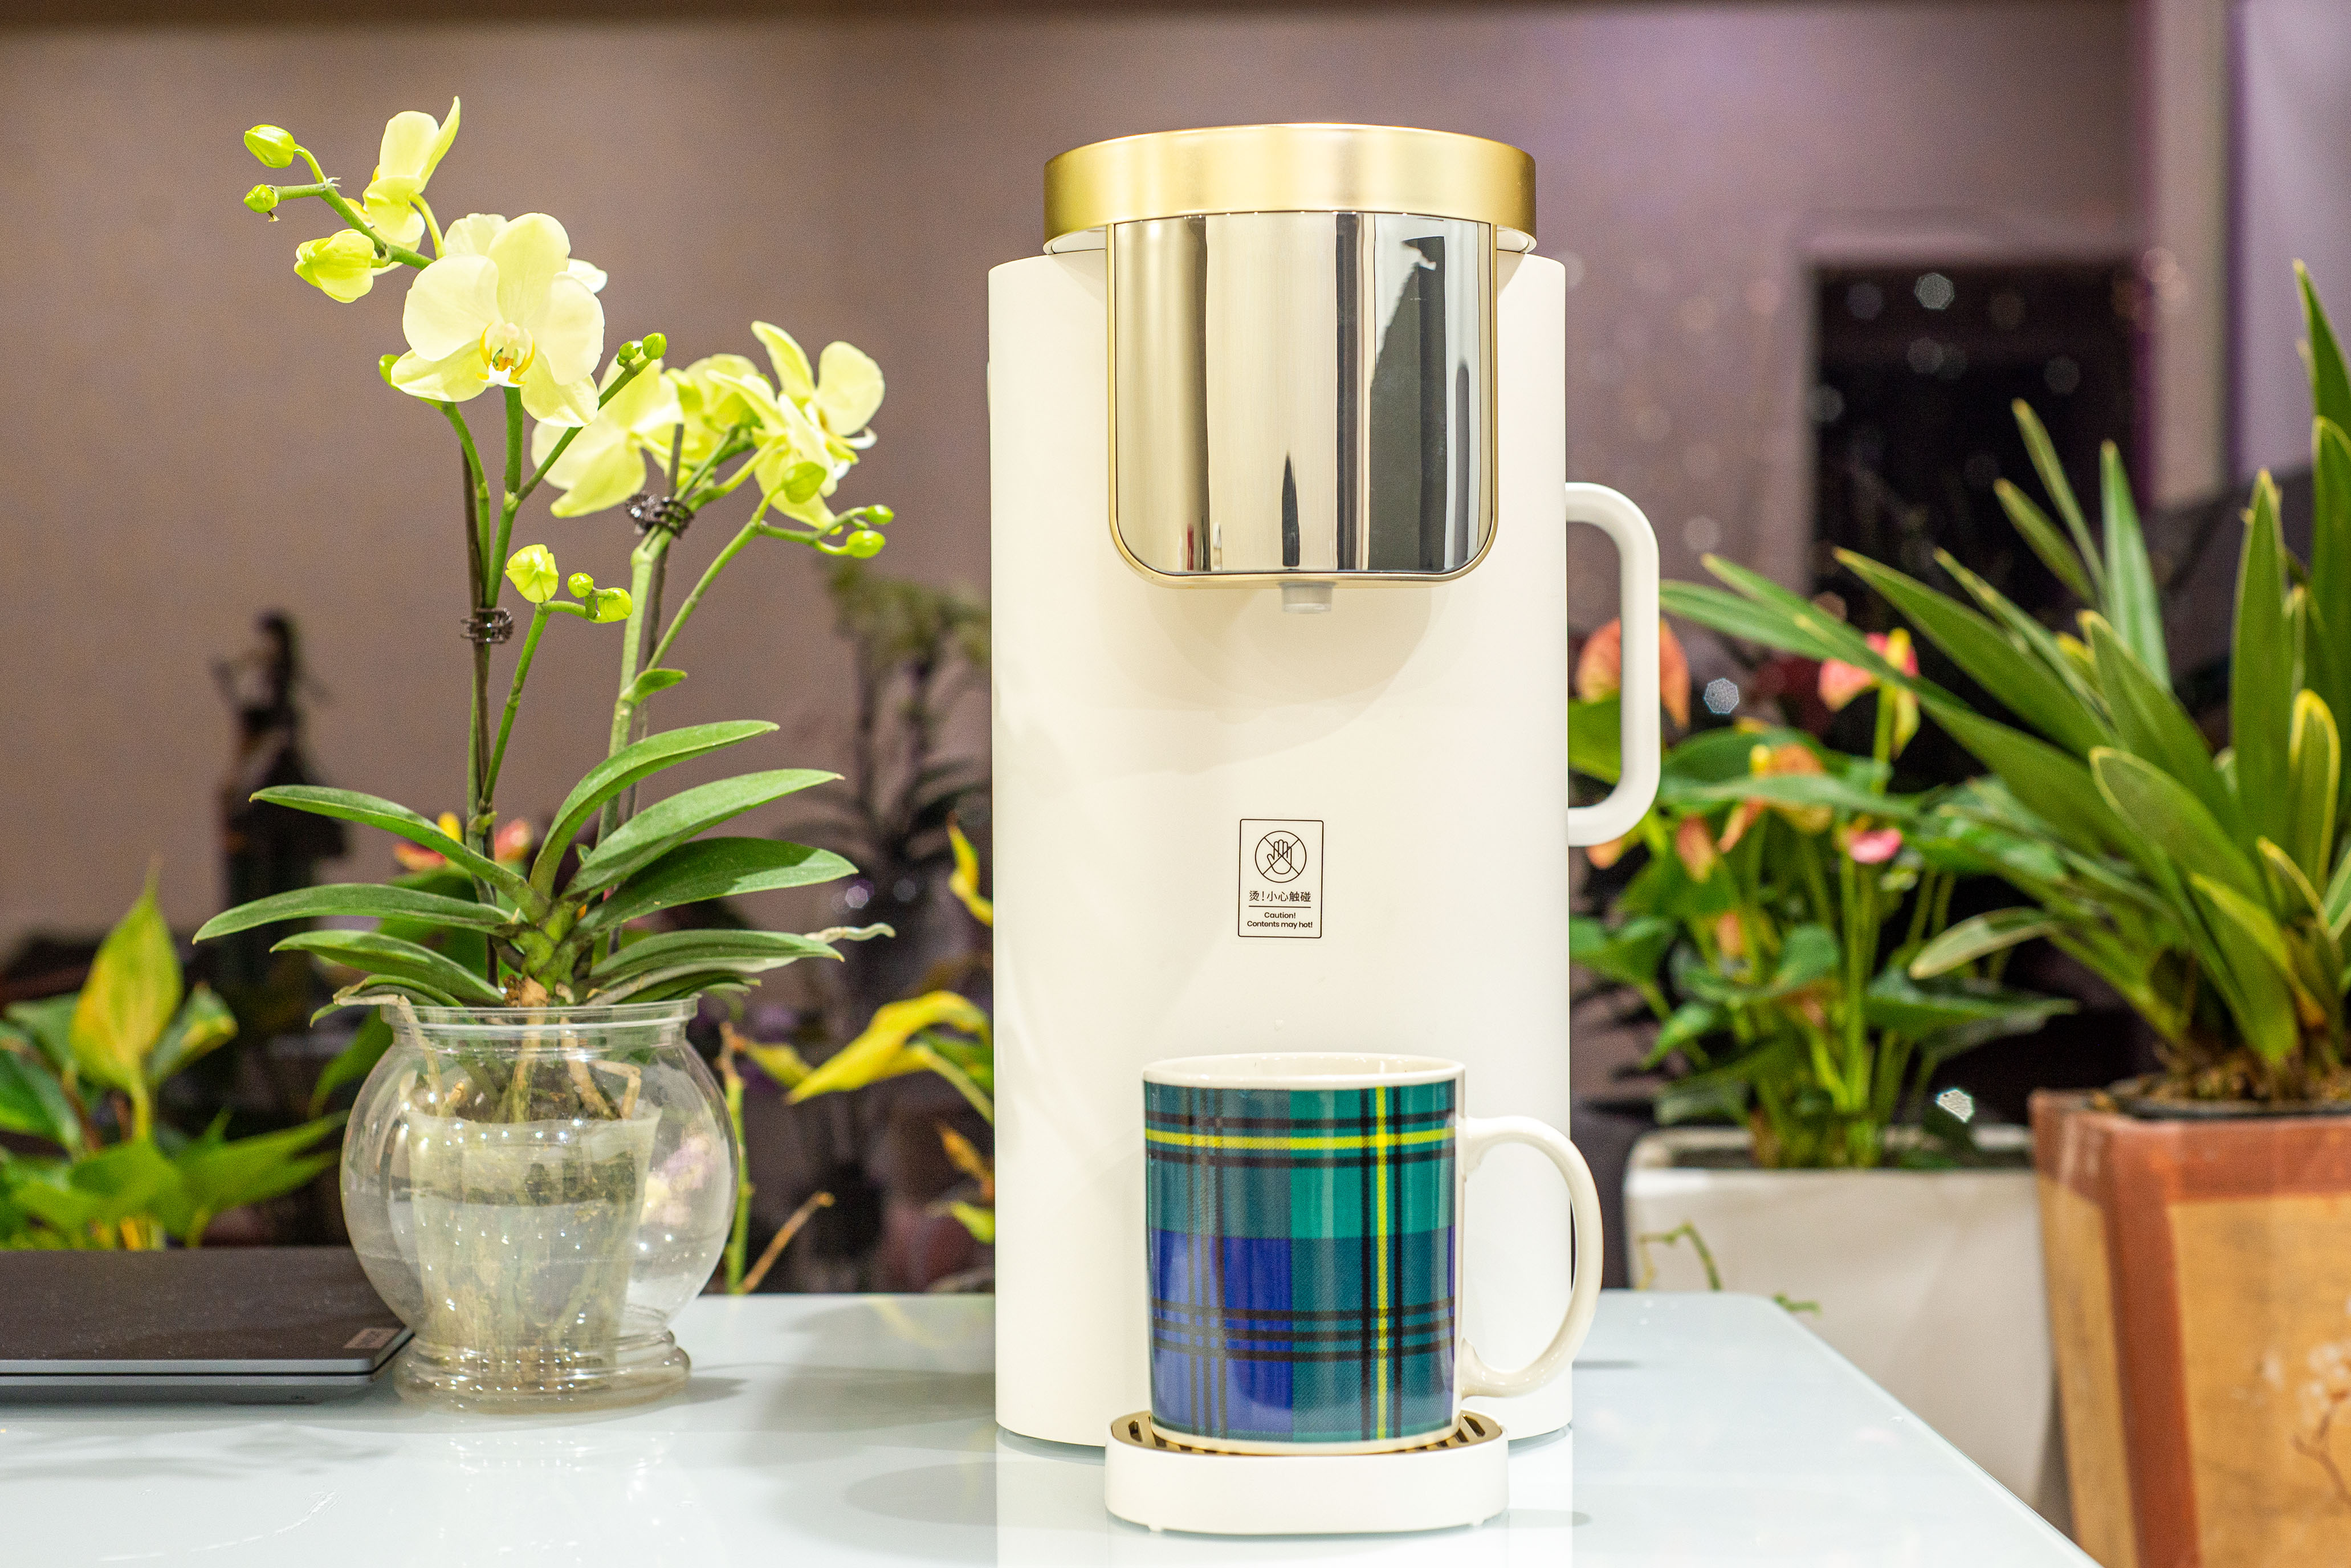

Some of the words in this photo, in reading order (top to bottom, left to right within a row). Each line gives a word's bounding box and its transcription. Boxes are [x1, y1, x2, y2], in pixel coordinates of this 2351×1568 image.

[1249, 890, 1311, 902] 烫!小心触碰
